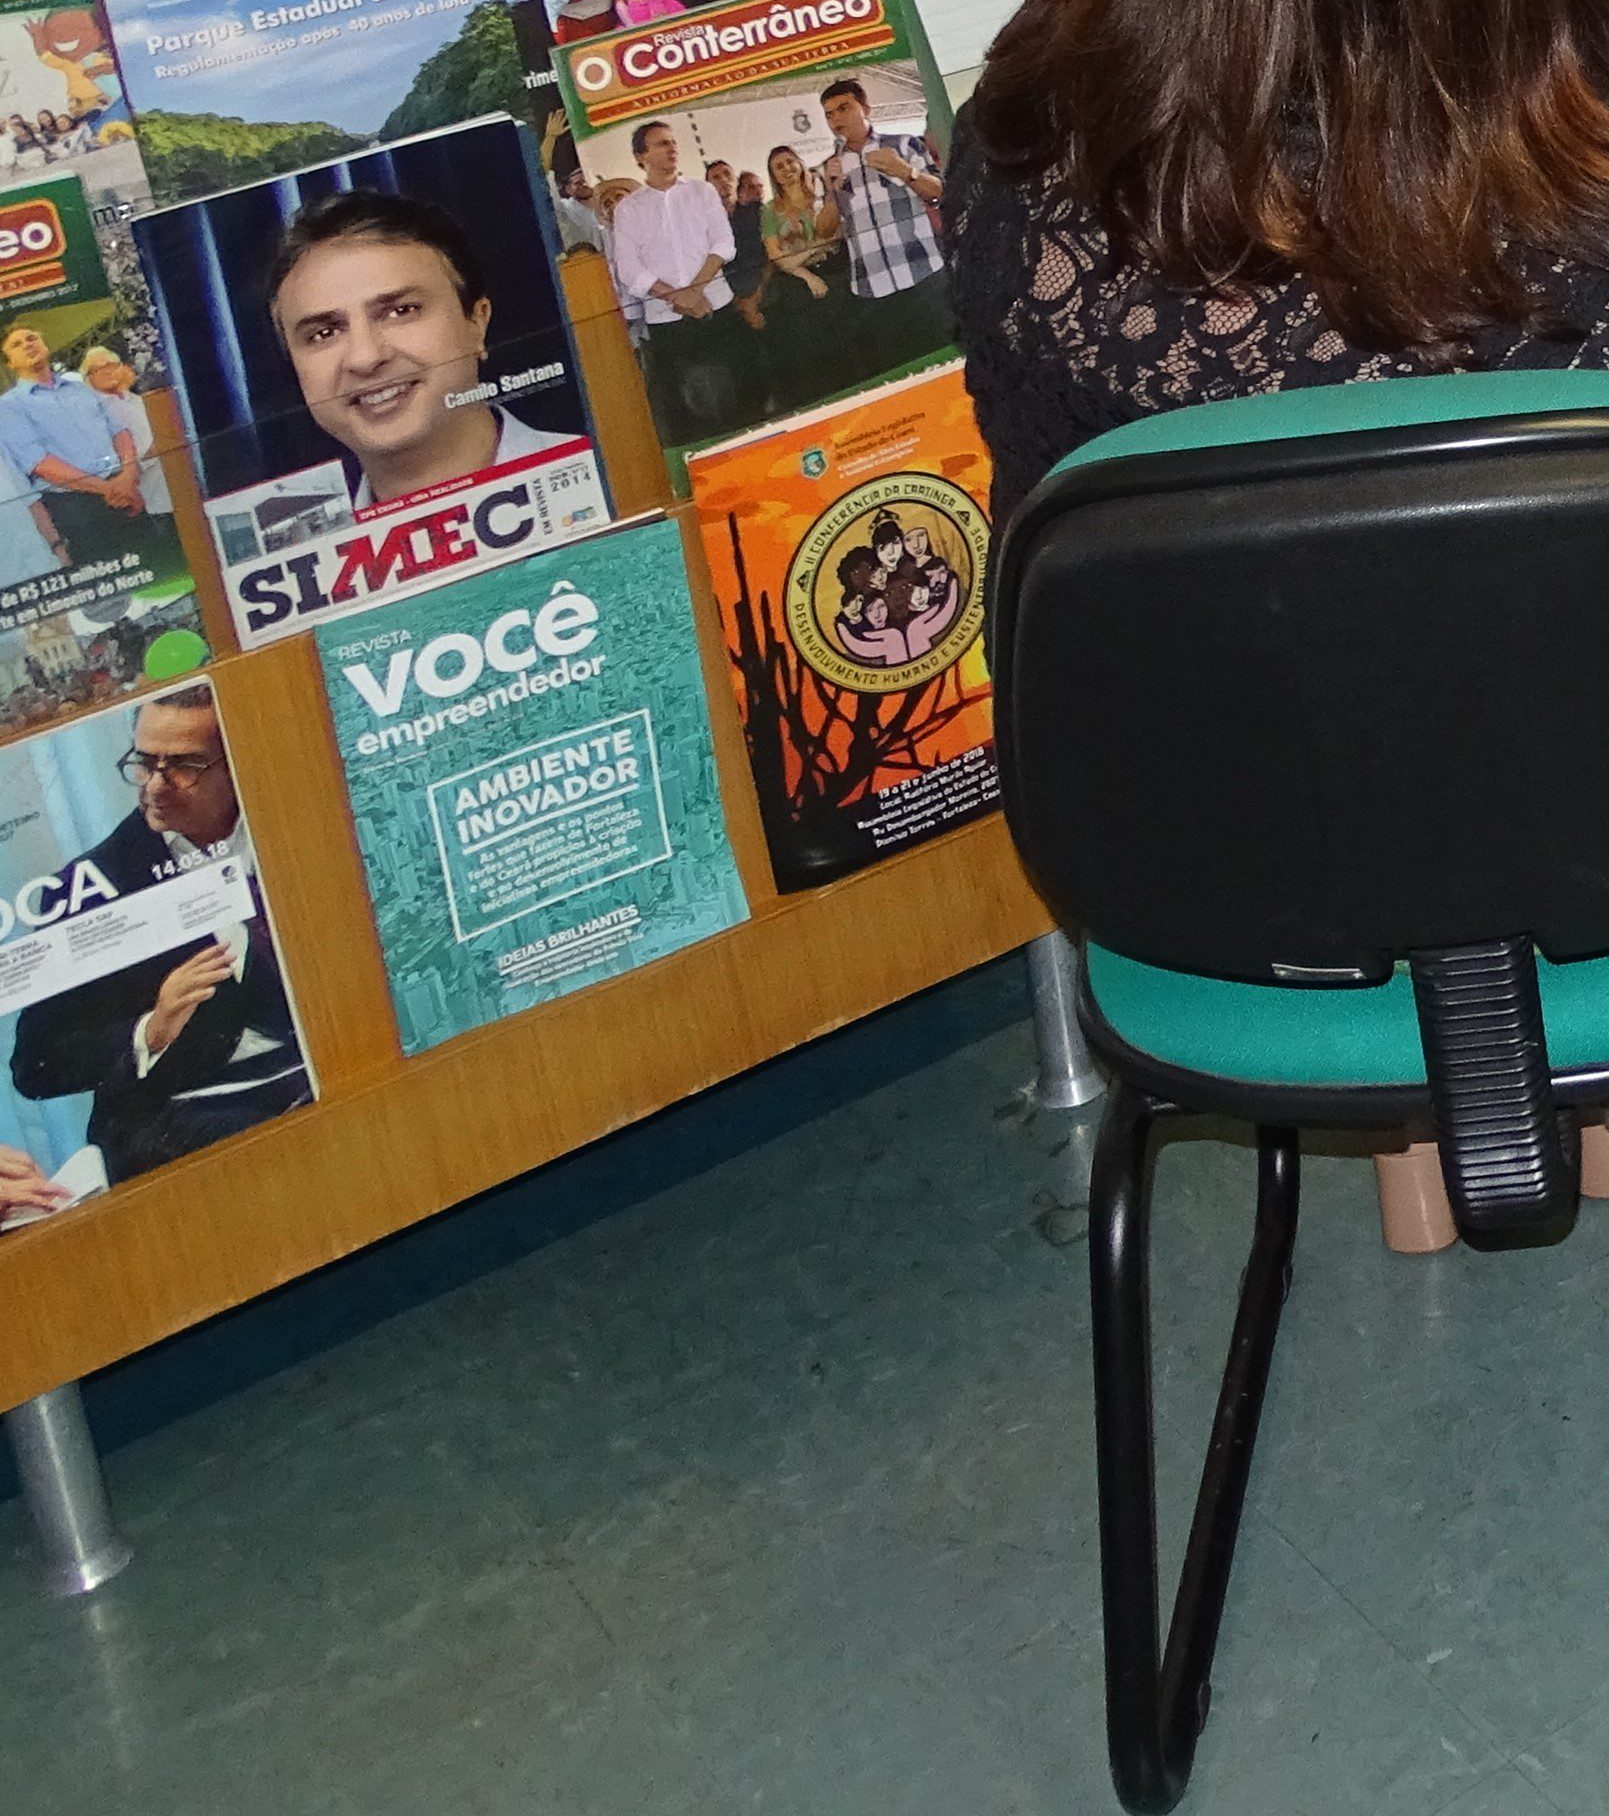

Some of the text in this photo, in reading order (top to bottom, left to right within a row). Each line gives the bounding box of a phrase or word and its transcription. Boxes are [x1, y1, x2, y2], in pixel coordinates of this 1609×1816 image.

[146, 18, 246, 56] Parque
[153, 36, 298, 80] Regulamentação
[300, 25, 343, 45] após
[349, 17, 370, 32] 40
[373, 9, 413, 28] anos
[415, 2, 436, 17] de
[575, 57, 612, 92] O
[654, 23, 706, 47] Revista
[444, 382, 499, 409] Camilo
[500, 362, 566, 393] Santana
[533, 477, 549, 519] REVISTA
[551, 472, 591, 493] 2014
[812, 490, 882, 555] CONFERÊNCIA
[885, 485, 900, 498] DA
[904, 484, 957, 509] CAATINGA
[41, 575, 68, 595] 121
[69, 559, 121, 586] milhões
[122, 552, 141, 569] de
[239, 483, 534, 633] SIMEC
[17, 608, 39, 624] em
[39, 588, 96, 616] Limoeiro
[98, 582, 115, 598] do
[115, 570, 155, 591] Norte
[338, 629, 413, 661] REVISTA
[794, 602, 879, 685] DESENVOLVIMENTO
[884, 656, 940, 684] HUMANO
[357, 654, 606, 756] empreendedor
[455, 729, 635, 816] AMBIENTE
[879, 788, 890, 800] 19
[950, 758, 962, 769] de
[457, 757, 640, 844] INOVADOR
[480, 852, 496, 865] As
[568, 817, 583, 828] os
[568, 828, 583, 841] de
[612, 835, 628, 847] de
[151, 840, 230, 881] 14.05.18
[498, 939, 547, 968] IDEIAS
[547, 903, 639, 948] BRILHANTES
